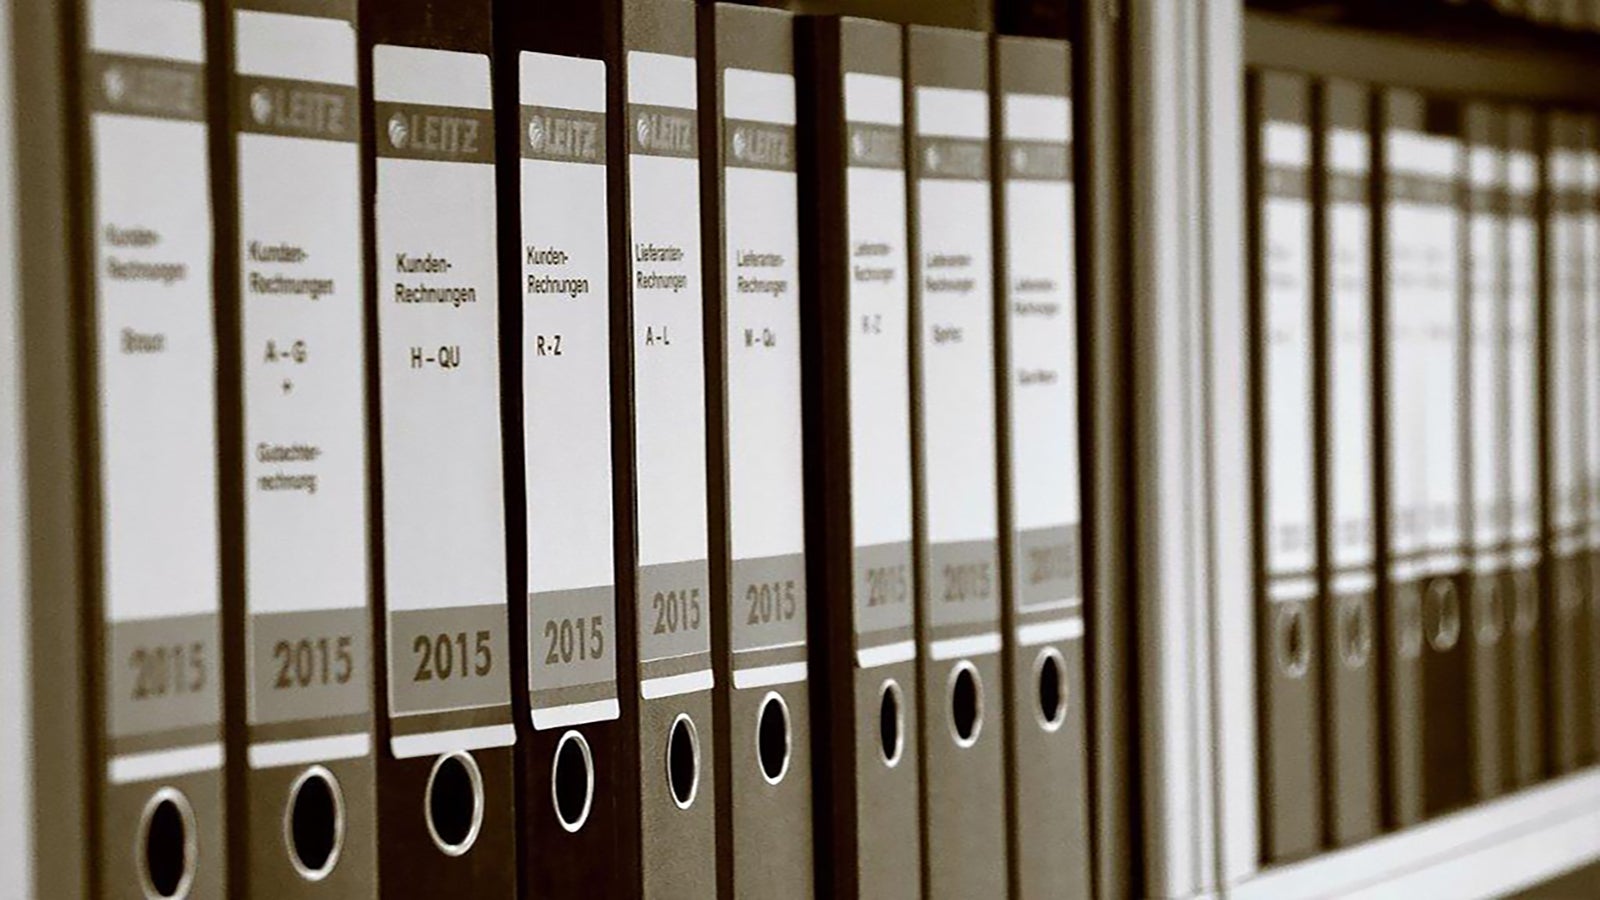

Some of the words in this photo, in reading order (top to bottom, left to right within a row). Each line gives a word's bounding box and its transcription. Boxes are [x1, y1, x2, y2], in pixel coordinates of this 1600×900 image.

[276, 89, 347, 134] LEITZ
[409, 115, 479, 153] LEITZ
[545, 120, 597, 157] LEITZ
[651, 115, 692, 149] LEITZ
[248, 241, 309, 264] Kunden-
[396, 253, 452, 275] Kunden-
[527, 246, 568, 267] Kunden-
[636, 244, 684, 263] Lieferanten-
[250, 273, 334, 300] Rechnungen
[396, 284, 476, 306] Rechnungen
[527, 275, 589, 298] Rechnungen
[636, 271, 687, 292] Rechnungen
[646, 328, 654, 345] A
[664, 328, 670, 345] L
[264, 342, 278, 362] A
[293, 342, 307, 362] G
[411, 349, 422, 368] H
[439, 348, 461, 370] QU
[258, 474, 317, 494] rechnung
[867, 564, 905, 607] 2015
[944, 562, 991, 601] 2015
[653, 589, 700, 634] 2015
[746, 581, 795, 625] 2015
[545, 616, 603, 665] 2015
[274, 637, 353, 689] 2015
[413, 630, 492, 682] 2015
